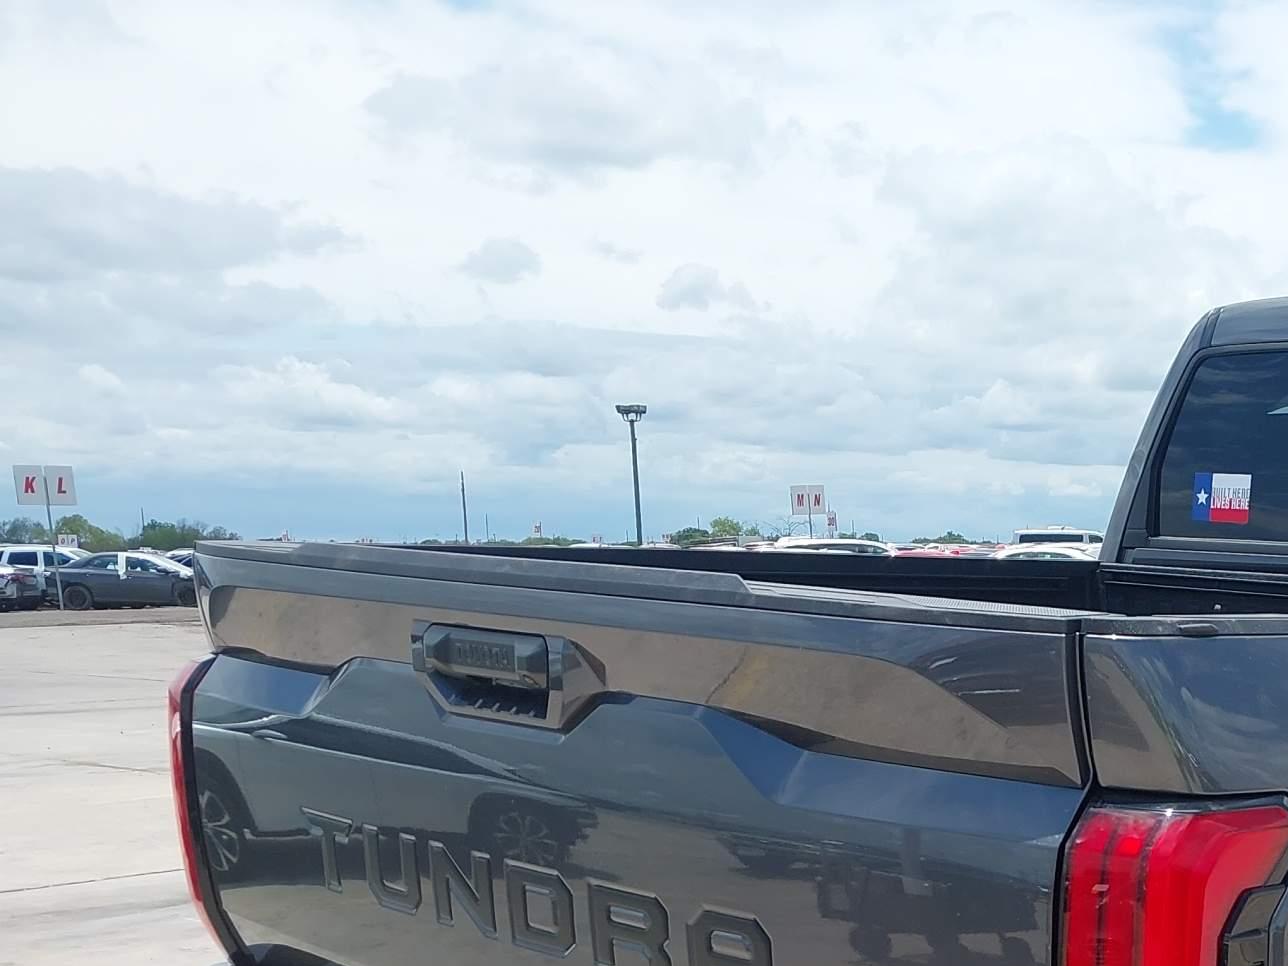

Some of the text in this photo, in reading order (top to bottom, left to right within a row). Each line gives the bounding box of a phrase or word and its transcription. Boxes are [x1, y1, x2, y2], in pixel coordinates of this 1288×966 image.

[24, 476, 67, 494] K L
[797, 493, 821, 507] M N
[1210, 496, 1249, 510] LIVES HERE
